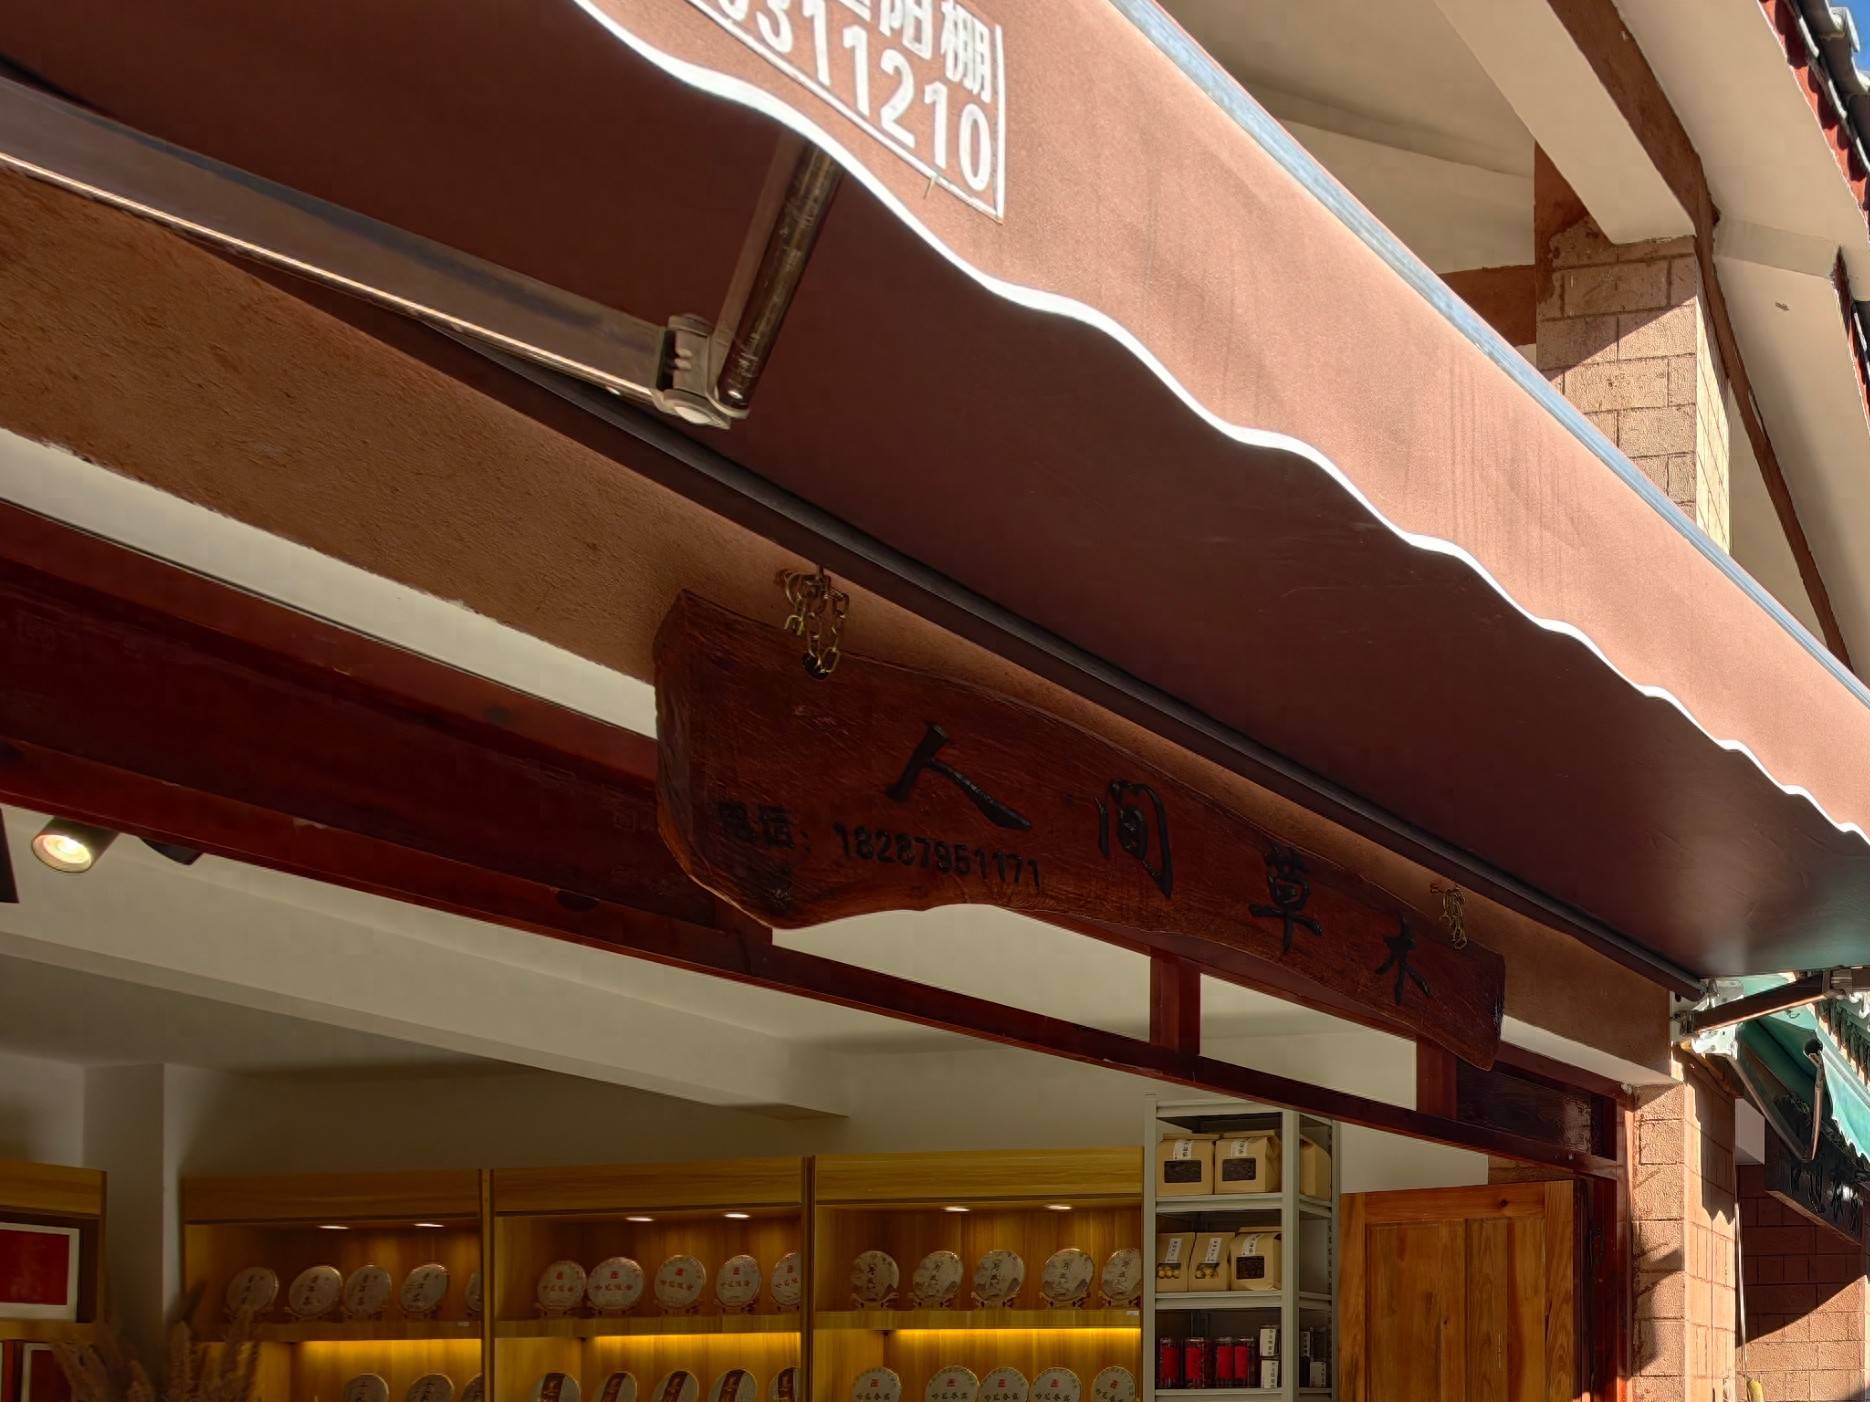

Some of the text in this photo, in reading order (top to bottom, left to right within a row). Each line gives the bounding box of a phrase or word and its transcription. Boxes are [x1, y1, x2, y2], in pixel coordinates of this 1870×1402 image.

[718, 0, 993, 192] 311210
[838, 0, 993, 102] 阳棚
[885, 722, 1432, 1003] 人间草木
